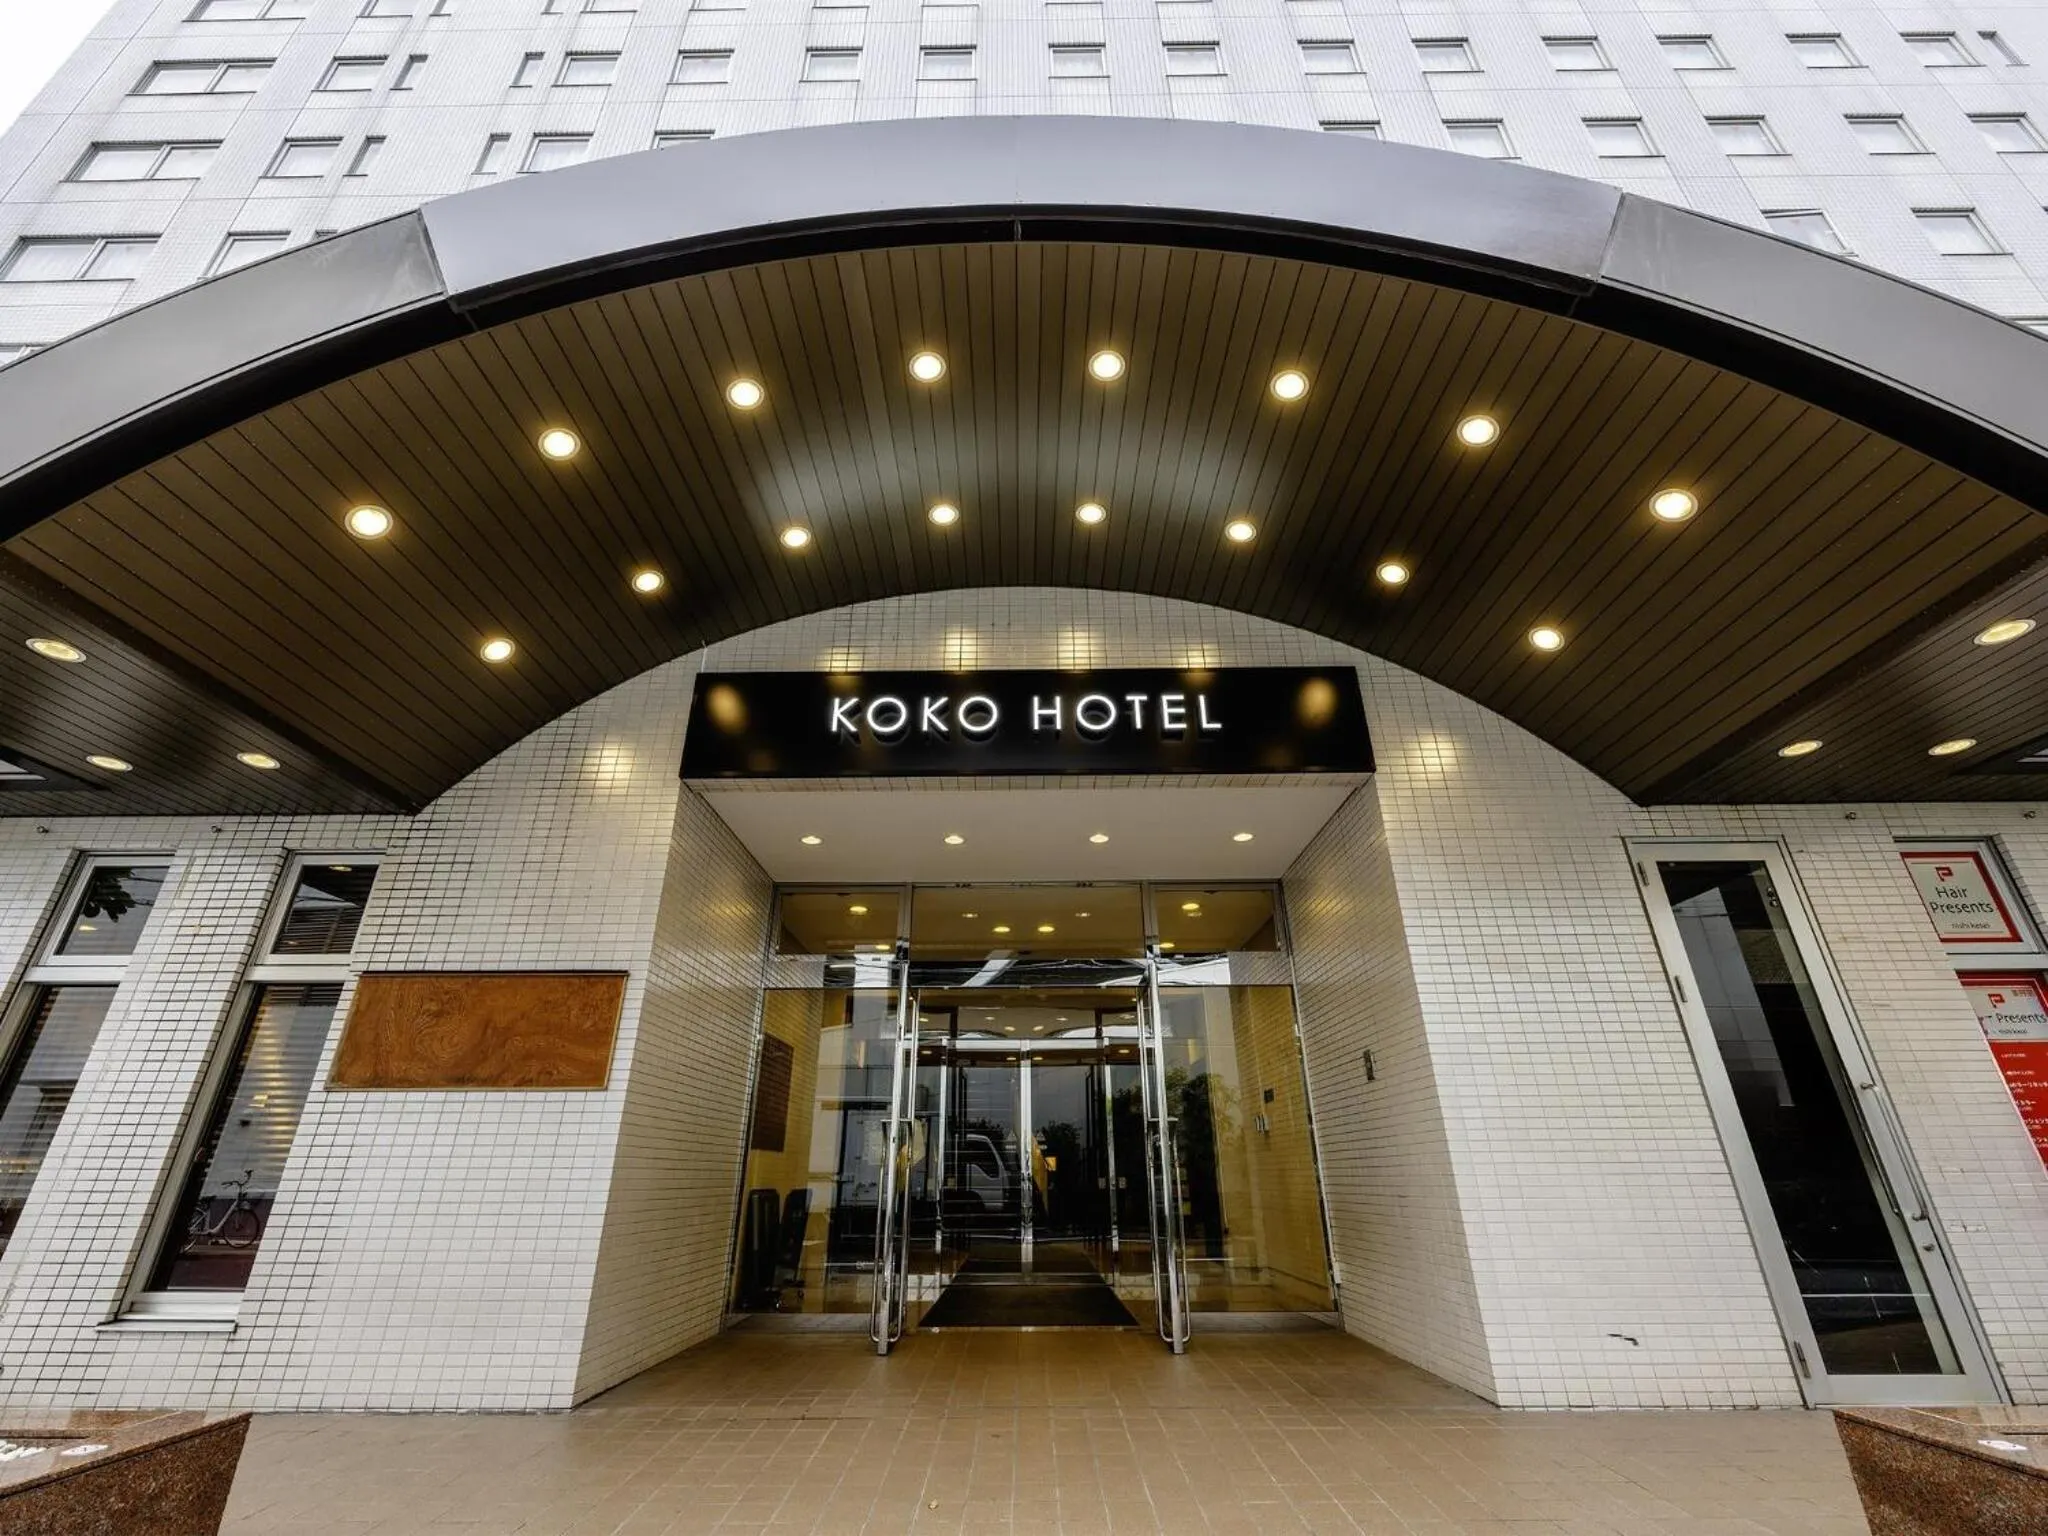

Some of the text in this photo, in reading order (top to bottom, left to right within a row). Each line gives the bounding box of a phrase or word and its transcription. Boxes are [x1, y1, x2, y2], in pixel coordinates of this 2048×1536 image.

[831, 694, 1222, 733] KOKO HOTEL
[1935, 886, 1968, 899] Hair
[1929, 901, 1994, 914] Presents
[1995, 1012, 2047, 1024] Presents
